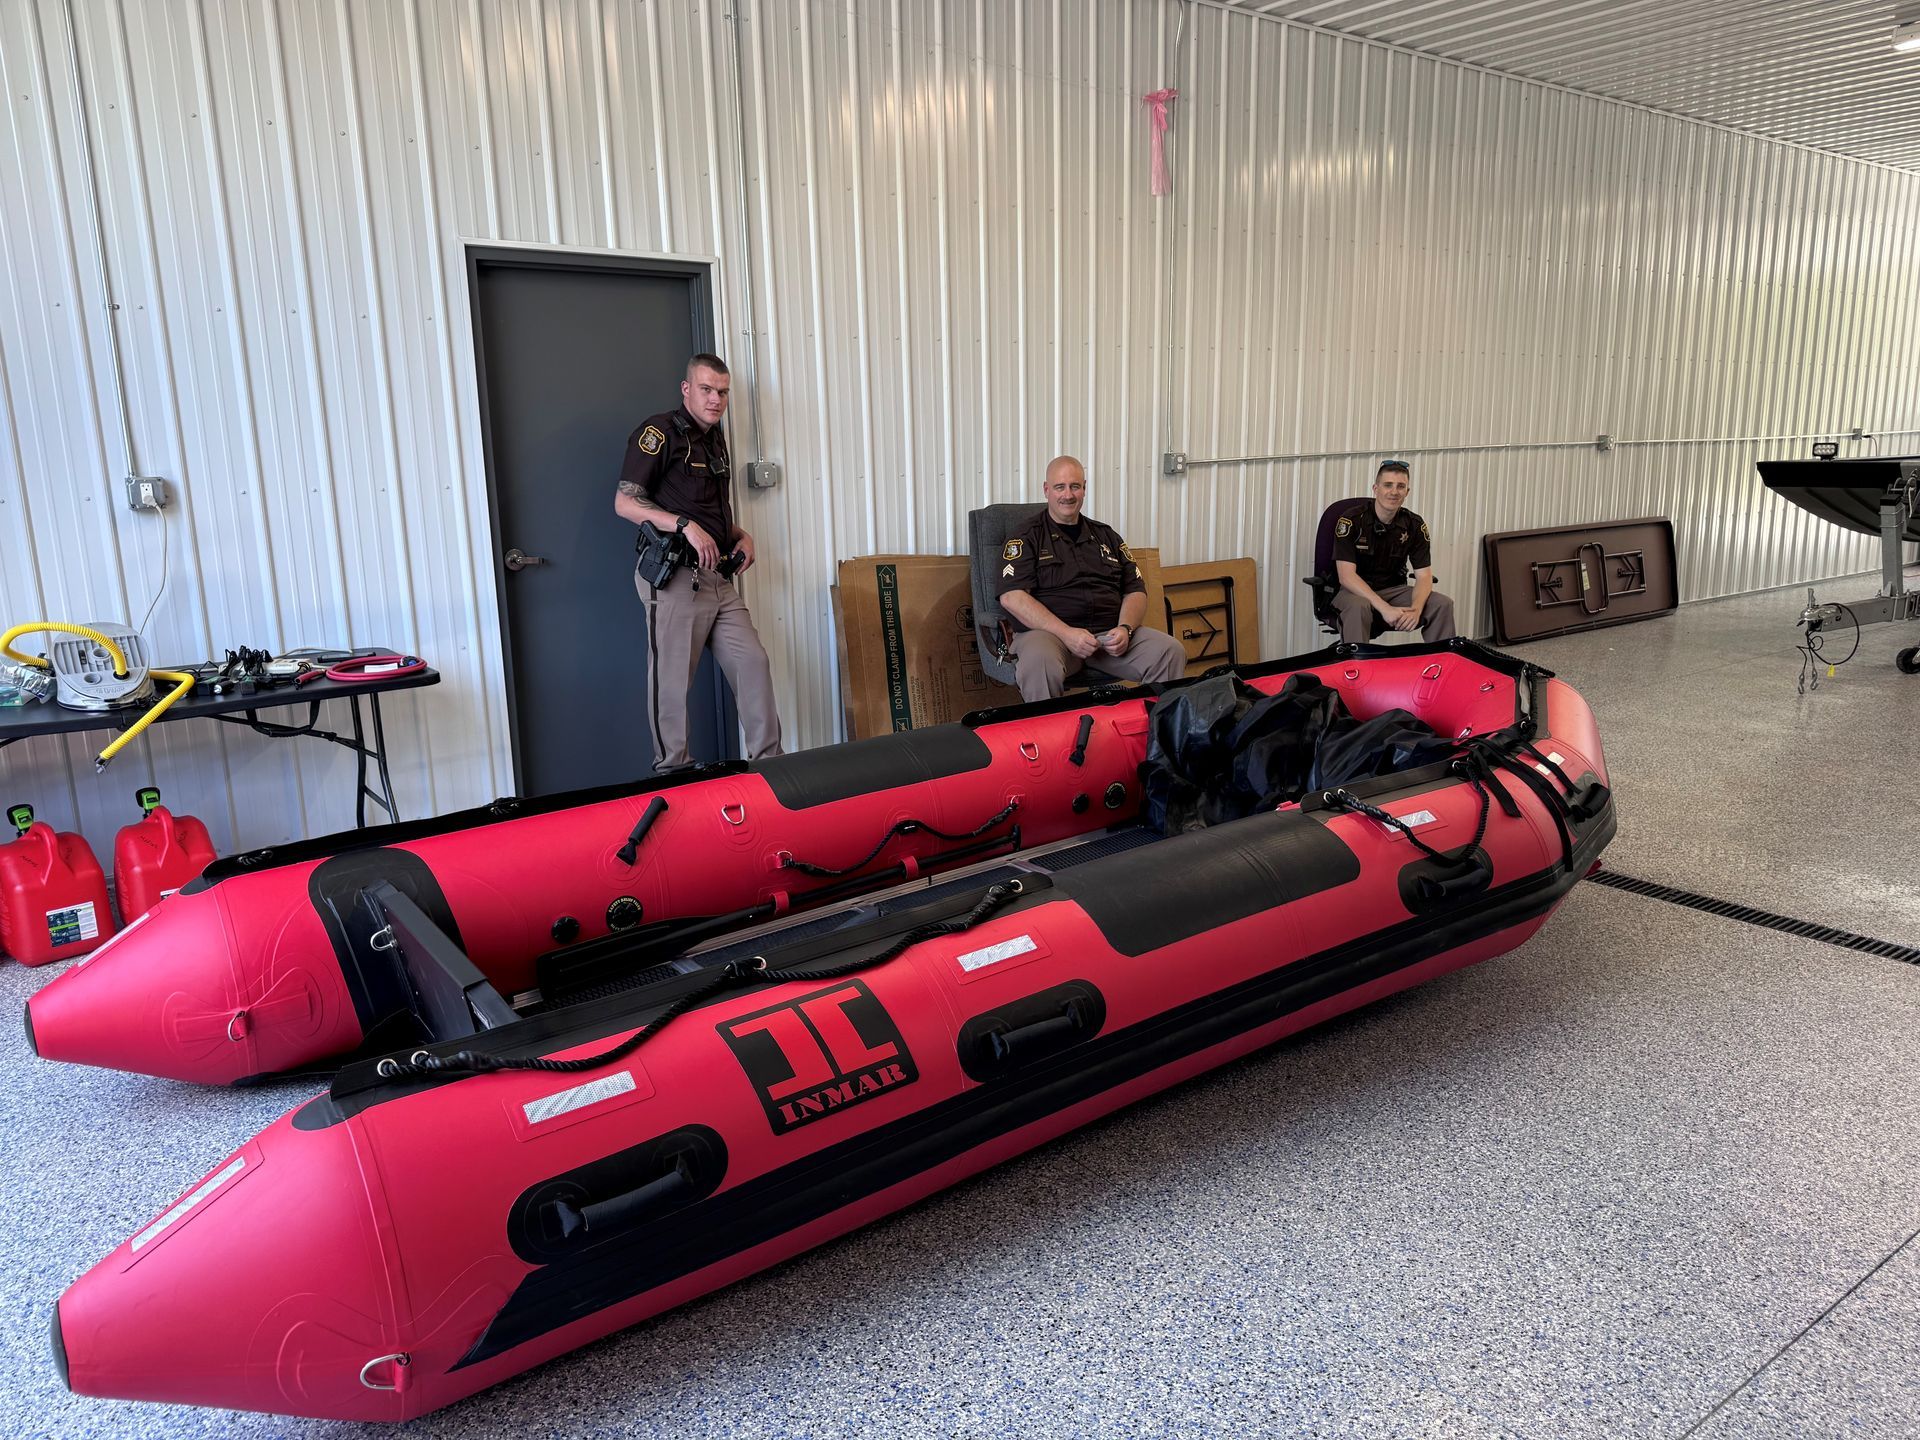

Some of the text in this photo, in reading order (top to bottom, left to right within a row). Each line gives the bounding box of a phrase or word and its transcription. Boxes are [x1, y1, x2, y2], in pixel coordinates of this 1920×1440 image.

[884, 591, 903, 710] DO NOT CLAMP FROM THIS SIDE
[778, 1063, 907, 1125] INMAR
